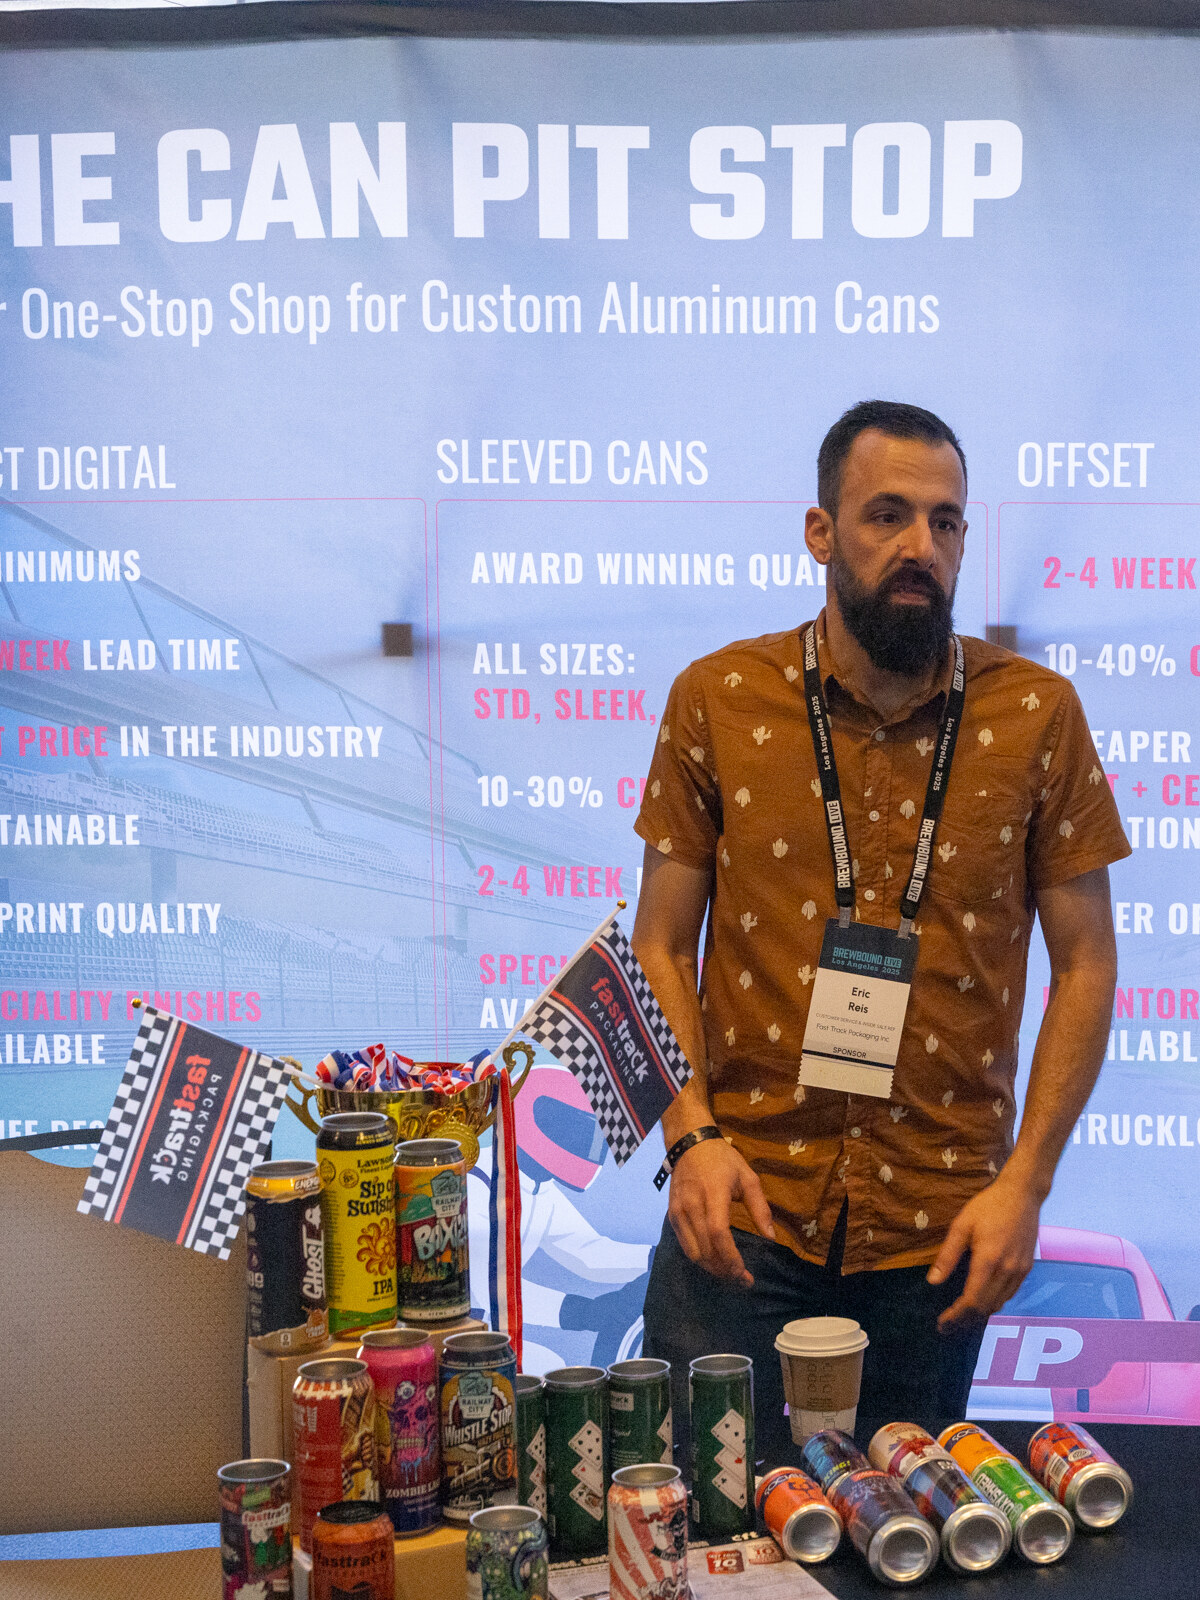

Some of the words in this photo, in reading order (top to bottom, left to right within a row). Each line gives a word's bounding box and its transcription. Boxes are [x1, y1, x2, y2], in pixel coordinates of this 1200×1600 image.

[157, 122, 409, 243] CAN
[452, 122, 650, 240] PIT
[689, 120, 1024, 240] STOP
[22, 286, 214, 348] One-Stop
[229, 281, 331, 345] Shop
[347, 281, 407, 333] for
[421, 279, 583, 334] Custom
[598, 281, 817, 335] Aluminum
[833, 280, 940, 334] Cans
[37, 445, 177, 491] DIGITAL
[436, 438, 592, 486] SLEEVED
[606, 440, 710, 486] CANS
[1017, 442, 1155, 489] OFFSET
[0, 549, 142, 583] INIMUMS
[471, 551, 584, 585] AWARD
[596, 552, 735, 586] WINNING
[1043, 556, 1099, 589] 2-4
[1112, 556, 1197, 590] WEEK
[83, 639, 156, 671] LEAD
[168, 639, 240, 671] TIME
[472, 642, 528, 676] ALL
[540, 643, 636, 676] SIZES:
[1043, 642, 1177, 678] 10-40%
[473, 687, 542, 725] STD,
[554, 688, 656, 726] SLEEK,
[813, 695, 822, 716] 2025
[816, 717, 831, 753] Angeles
[947, 717, 955, 729] Los
[18, 726, 109, 757] PRICE
[120, 726, 150, 757] IN
[162, 726, 217, 757] THE
[231, 726, 384, 758] INDUSTRY
[937, 728, 952, 769] Angeles
[823, 754, 832, 771] Los
[477, 775, 604, 809] 10-30%
[932, 770, 943, 792] 2025
[827, 800, 842, 823] LIVE
[477, 865, 531, 897] 2-4
[543, 866, 624, 897] WEEK
[906, 879, 923, 902] LIVE
[96, 903, 222, 938] QUALITY
[831, 957, 845, 966] Los
[846, 960, 879, 972] Angeles
[882, 966, 900, 976] 2025
[884, 956, 902, 969] LIVE
[0, 990, 113, 1021] CIALITY
[848, 1002, 869, 1014] Reis
[851, 986, 871, 999] Eric
[589, 1002, 635, 1087] PACKAGING
[591, 976, 649, 1084] fasttrack
[816, 1023, 829, 1031] Fast
[830, 1025, 848, 1034] Track
[848, 1029, 880, 1042] Packaging
[880, 1035, 890, 1043] Inc
[0, 1034, 106, 1065] ILABLE
[832, 1046, 867, 1059] SPONSOR
[360, 1176, 385, 1200] Sip
[435, 1193, 461, 1206] RAILWAY
[441, 1203, 456, 1212] CITY
[302, 1223, 327, 1300] GHOST
[373, 1277, 394, 1296] IPA
[462, 1398, 492, 1407] RAILWAY
[468, 1405, 485, 1414] CITY
[386, 1484, 427, 1499] ZOMBIE
